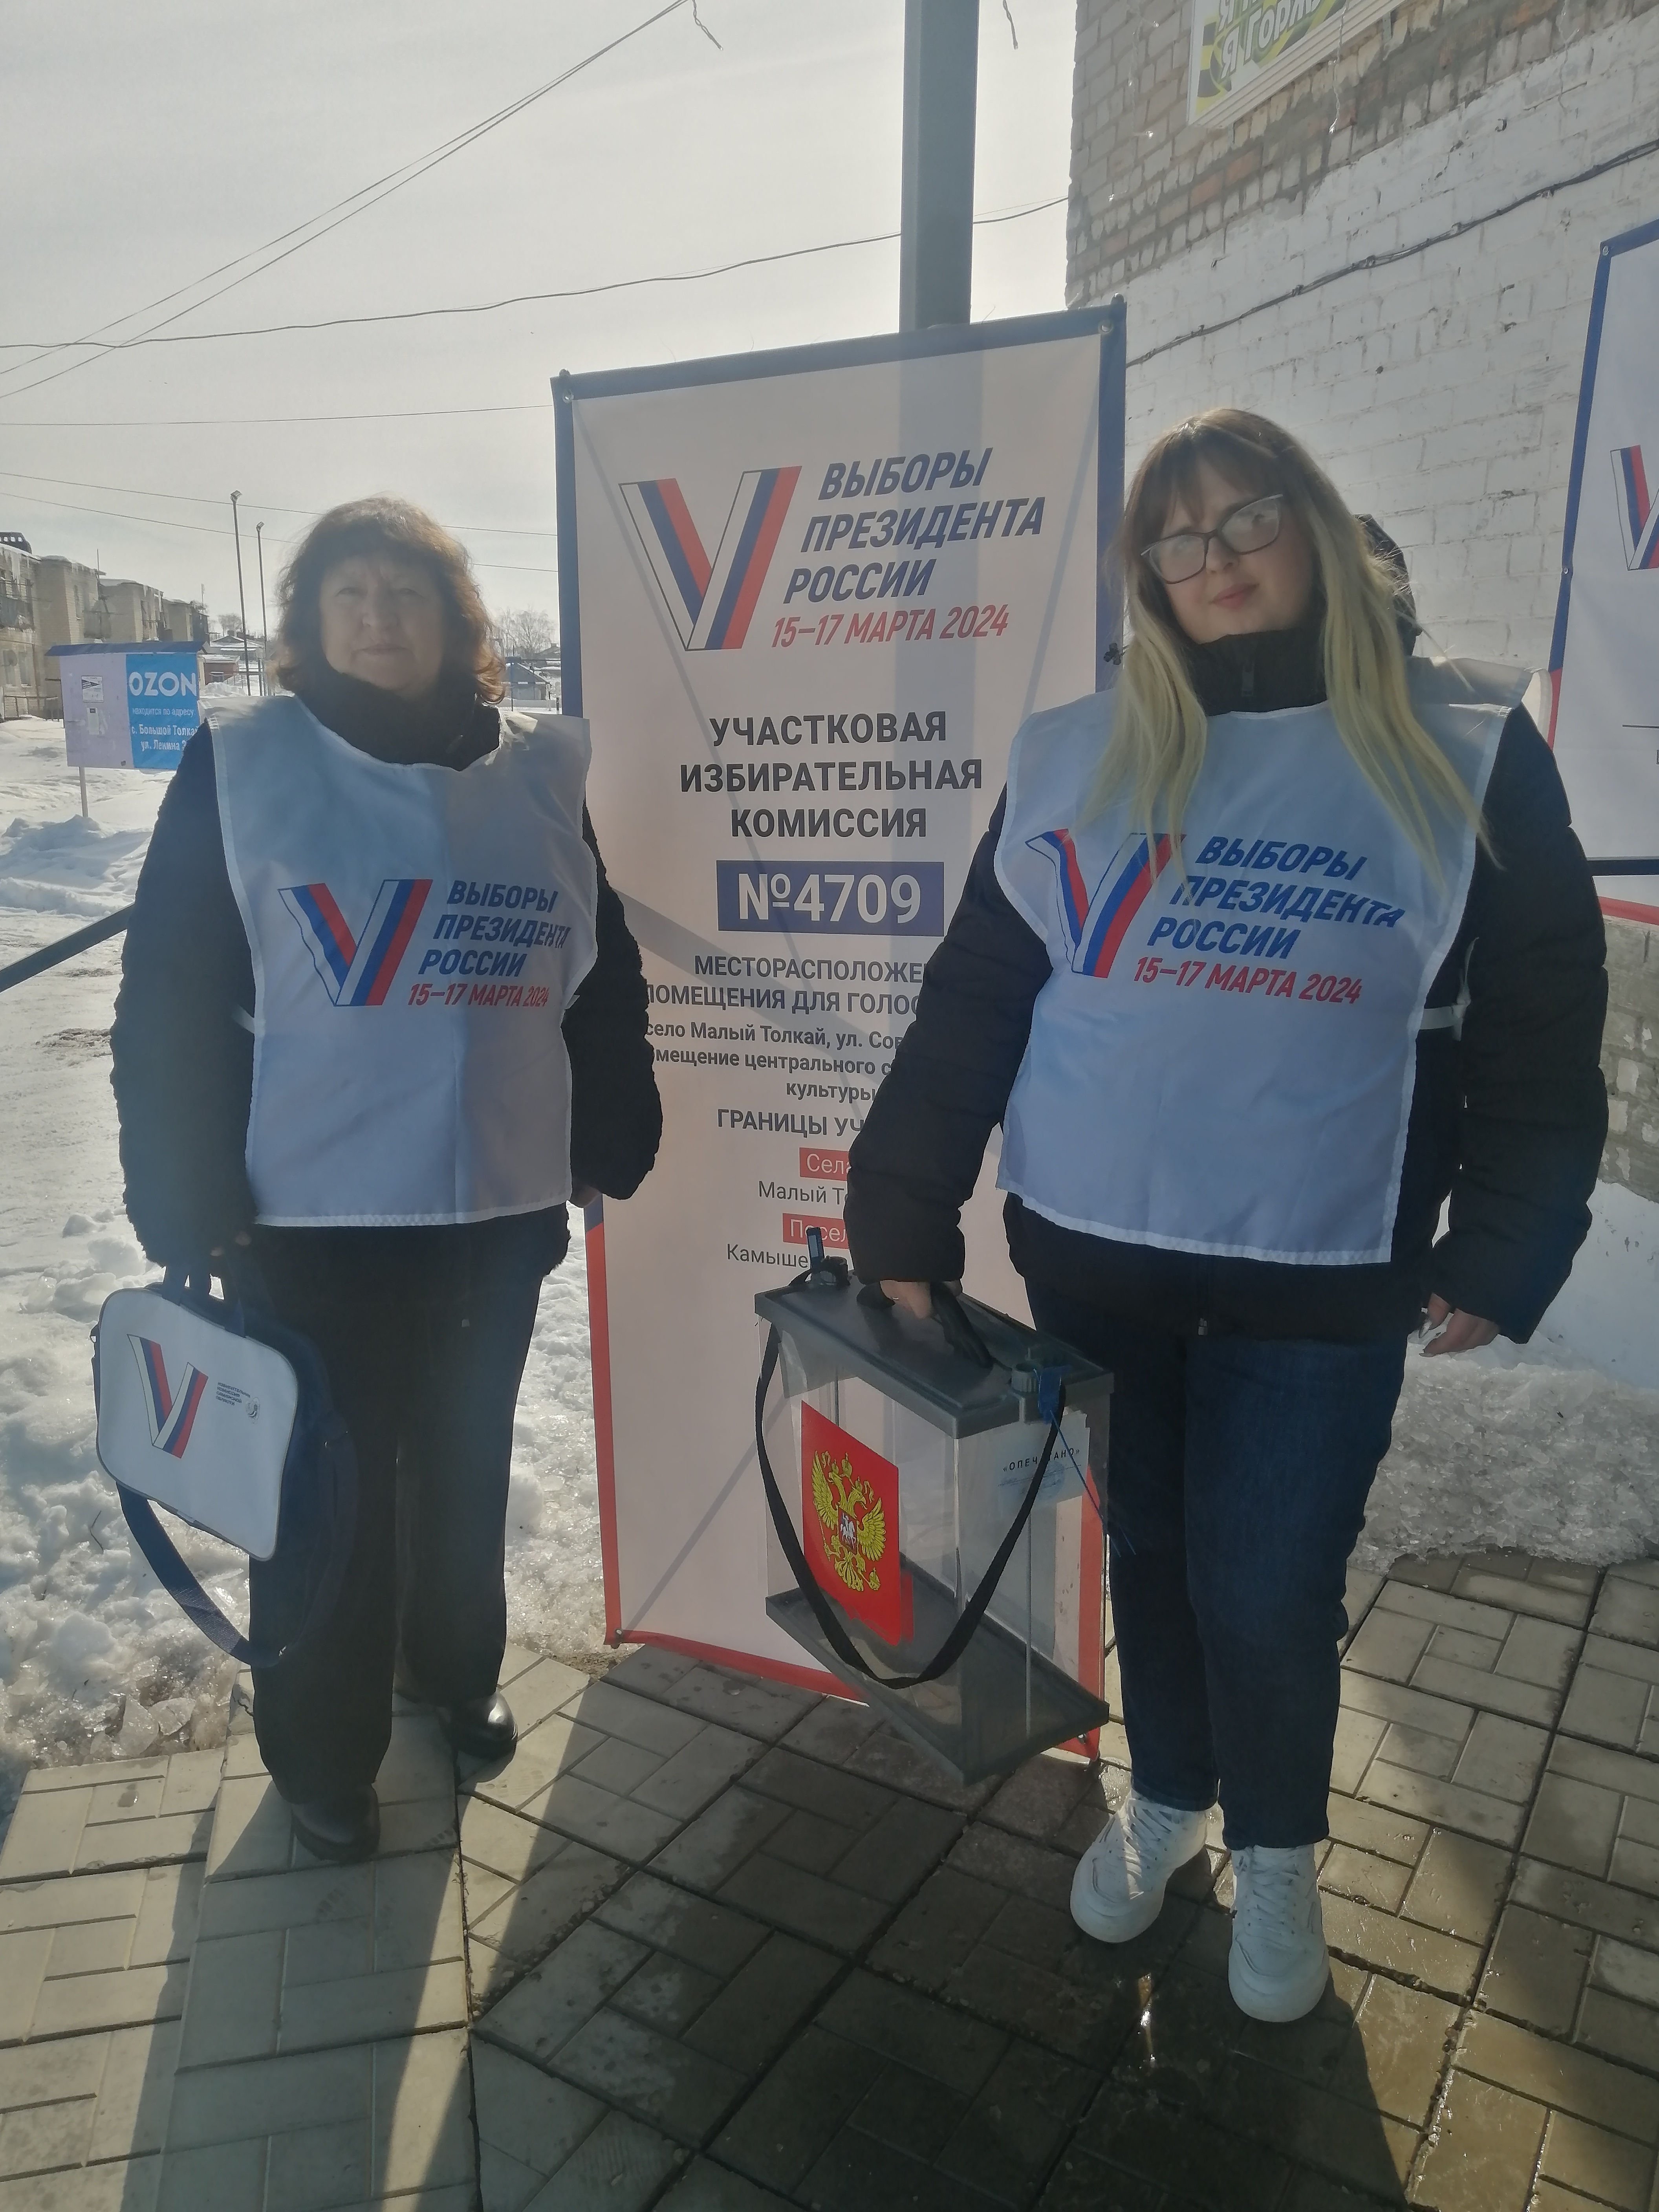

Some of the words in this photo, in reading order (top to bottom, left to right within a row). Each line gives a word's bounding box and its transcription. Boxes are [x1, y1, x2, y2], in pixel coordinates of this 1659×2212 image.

[1221, 26, 1240, 79] Я
[818, 447, 993, 500] ВЫБОРЫ
[800, 496, 1046, 552] ПРЕЗИДЕНТА
[782, 558, 936, 604] РОССИИ
[844, 608, 935, 644] МАРТА
[938, 604, 1009, 639] 2024
[129, 672, 197, 696] OZON
[172, 709, 194, 717] адресу
[139, 724, 170, 735] Большой
[709, 711, 946, 746] УЧАСТКОВАЯ
[154, 739, 180, 751] Ленина
[680, 759, 982, 792] ИЗБИРАТЕЛЬНАЯ
[731, 808, 926, 837] КОМИССИЯ
[1196, 835, 1368, 881] ВЫБОРЫ
[447, 880, 558, 913] ВЫБОРЫ
[738, 873, 921, 924] №4709
[1169, 875, 1406, 928] ПРЕЗИДЕНТА
[432, 914, 572, 948] ПРЕЗИДЕНТА
[1147, 917, 1301, 960] РОССИИ
[418, 949, 527, 977] РОССИИ
[695, 955, 926, 983] МЕСТОРАСПОЛОЖЕ
[467, 984, 524, 1006] МАРТА
[522, 986, 551, 1007] 2024
[1204, 964, 1301, 998] МАРТА
[1298, 974, 1362, 1003] 2024
[792, 991, 839, 1014] ДЛЯ
[691, 1022, 755, 1041] Малый
[760, 1025, 830, 1047] Толкай,
[836, 1033, 862, 1050] ул.
[745, 1054, 875, 1075] центрального
[786, 1082, 875, 1103] культуры
[717, 1109, 826, 1138] ГРАНИЦЫ
[759, 1181, 826, 1203] Малый
[1003, 1448, 1080, 1472] «ОПЕЧАНО»
